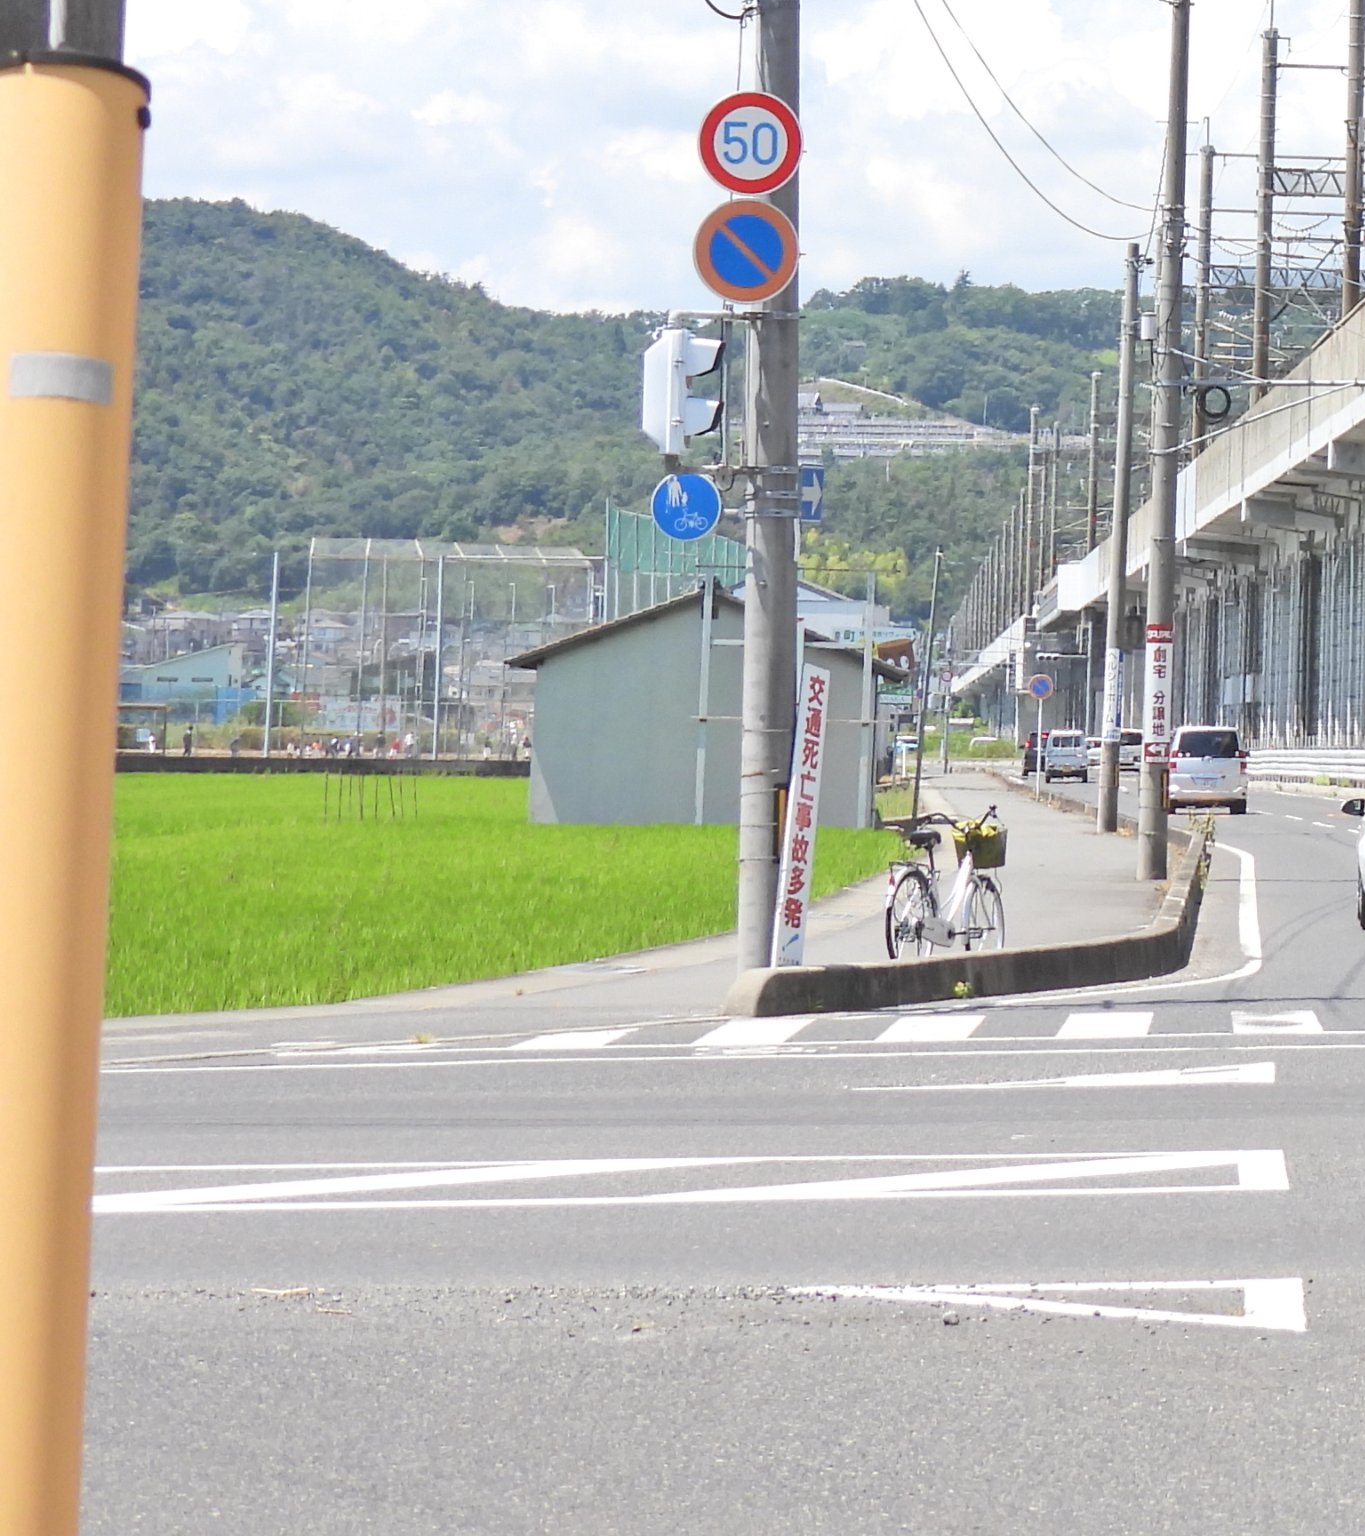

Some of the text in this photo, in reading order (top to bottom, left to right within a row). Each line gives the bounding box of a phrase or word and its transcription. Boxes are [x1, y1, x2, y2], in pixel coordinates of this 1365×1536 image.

[723, 121, 778, 165] 50
[1152, 645, 1167, 680] 創宅
[1152, 690, 1166, 737] 分譲地
[784, 675, 826, 929] 交通死亡事故多発
